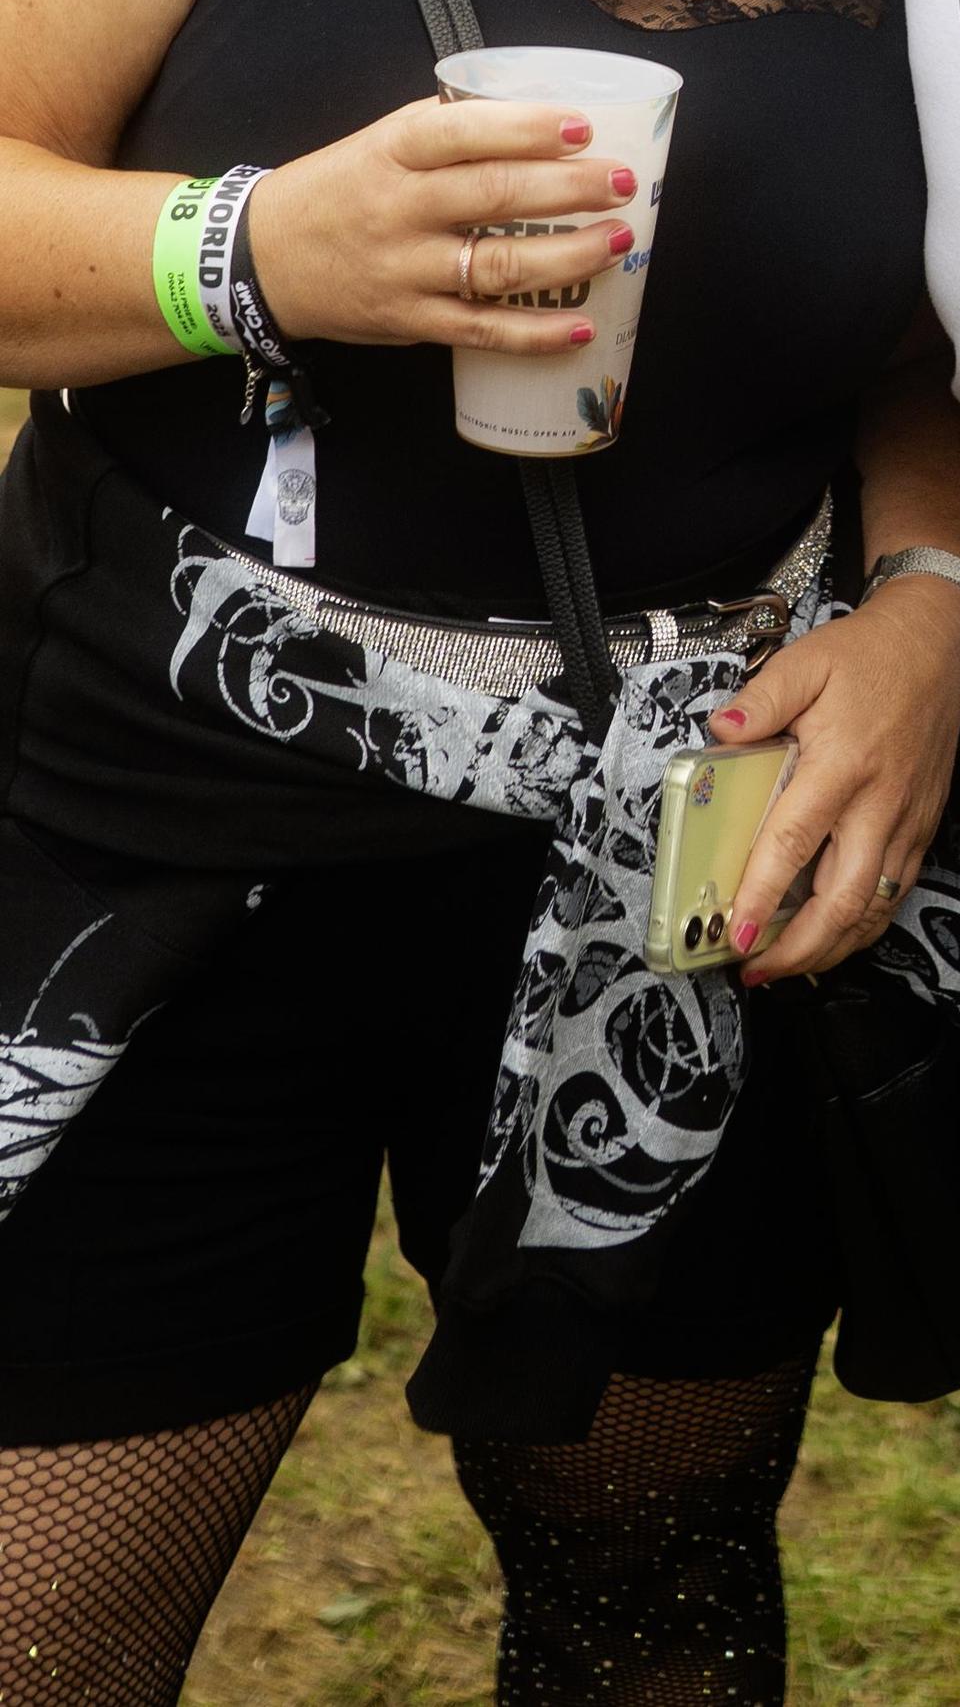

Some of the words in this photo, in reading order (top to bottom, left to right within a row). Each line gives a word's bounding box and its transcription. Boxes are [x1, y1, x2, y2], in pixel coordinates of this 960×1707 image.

[200, 164, 261, 289] RWORLD
[501, 425, 529, 437] MUSIC
[532, 429, 558, 437] OPEN
[561, 429, 577, 437] AIR
